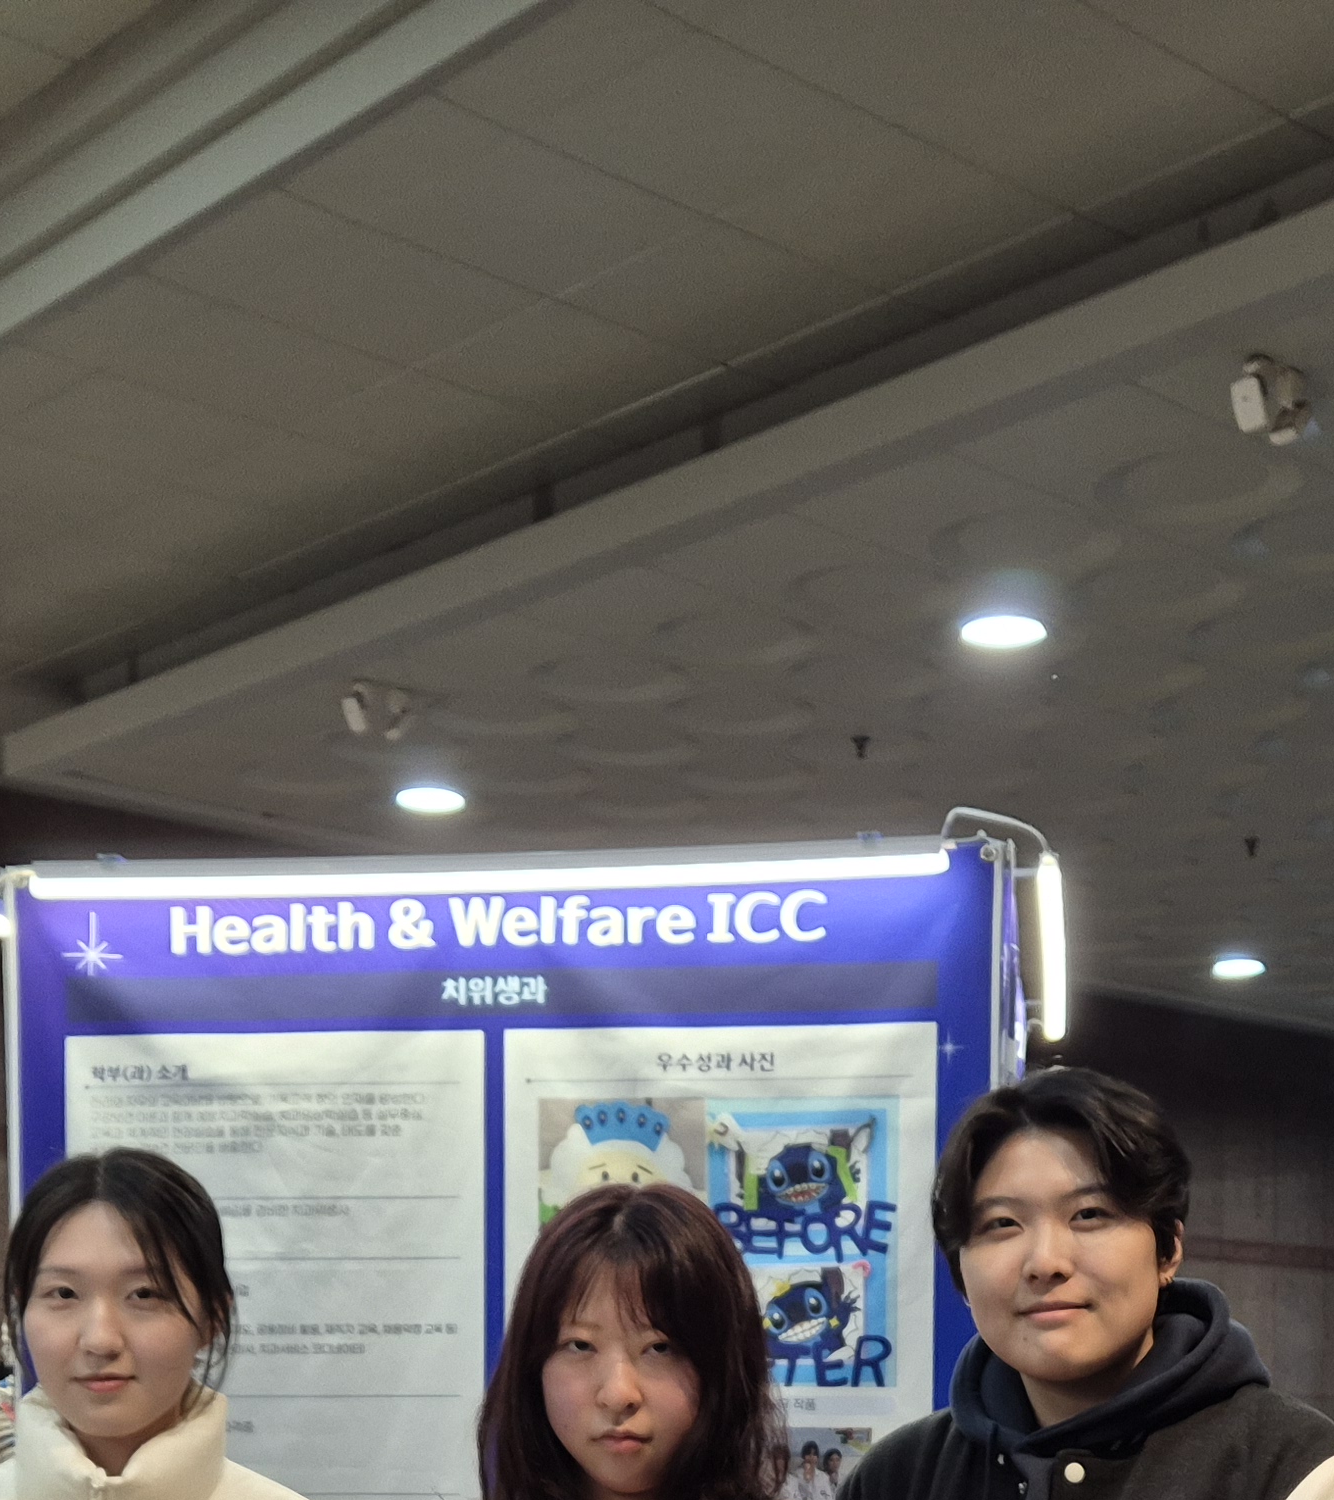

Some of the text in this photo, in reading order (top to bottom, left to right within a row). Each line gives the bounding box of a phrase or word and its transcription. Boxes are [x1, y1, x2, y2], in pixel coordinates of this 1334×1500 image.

[168, 888, 828, 956] Health & Welfare ICC
[442, 976, 548, 1005] 치위생과
[158, 1064, 189, 1081] 소개
[656, 1052, 775, 1072] 우수성과 사진
[716, 1200, 897, 1263] BEFORE
[767, 1334, 892, 1388] TER
